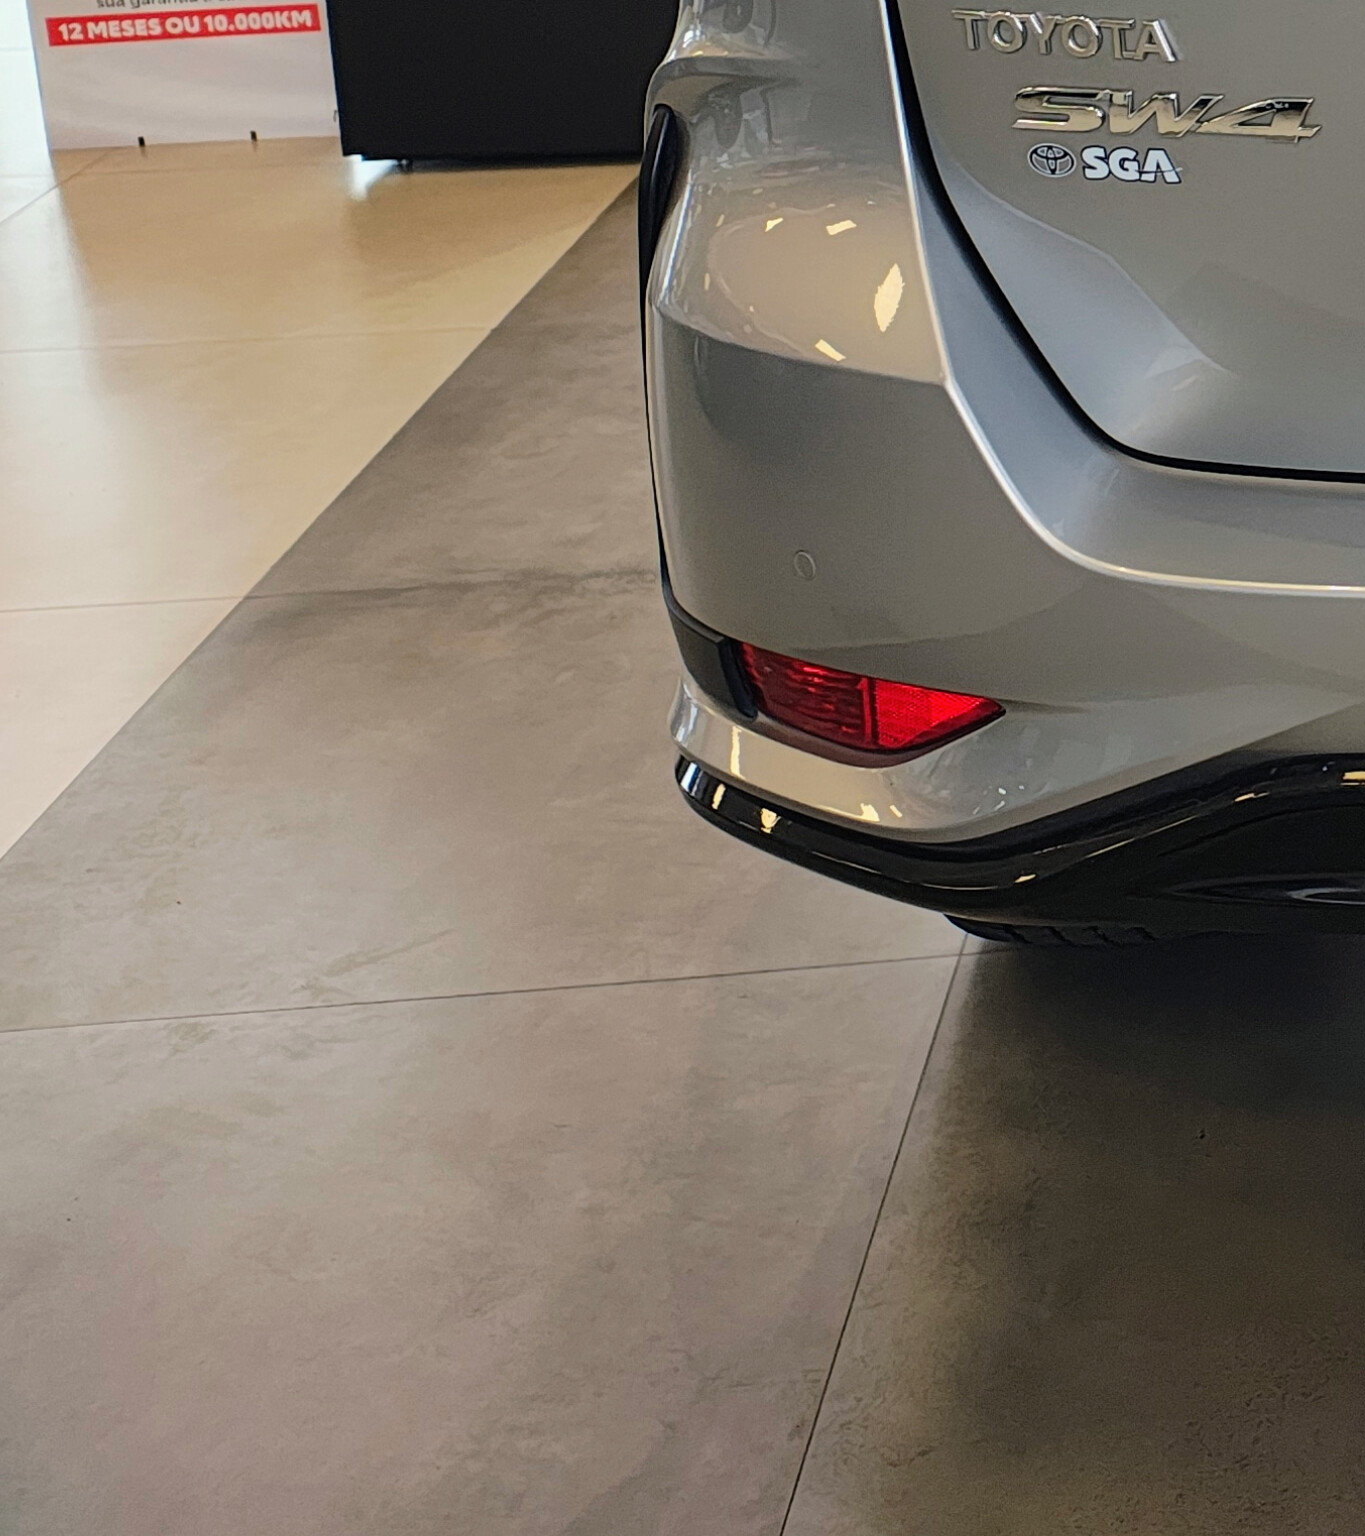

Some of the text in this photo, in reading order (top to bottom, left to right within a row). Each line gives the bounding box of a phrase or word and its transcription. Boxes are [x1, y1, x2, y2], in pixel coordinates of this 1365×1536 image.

[59, 9, 313, 41] 12 MESES OU 10.000KM
[952, 7, 1182, 63] TOYOTA
[1011, 84, 1322, 144] SW4
[1080, 144, 1183, 184] SGA
